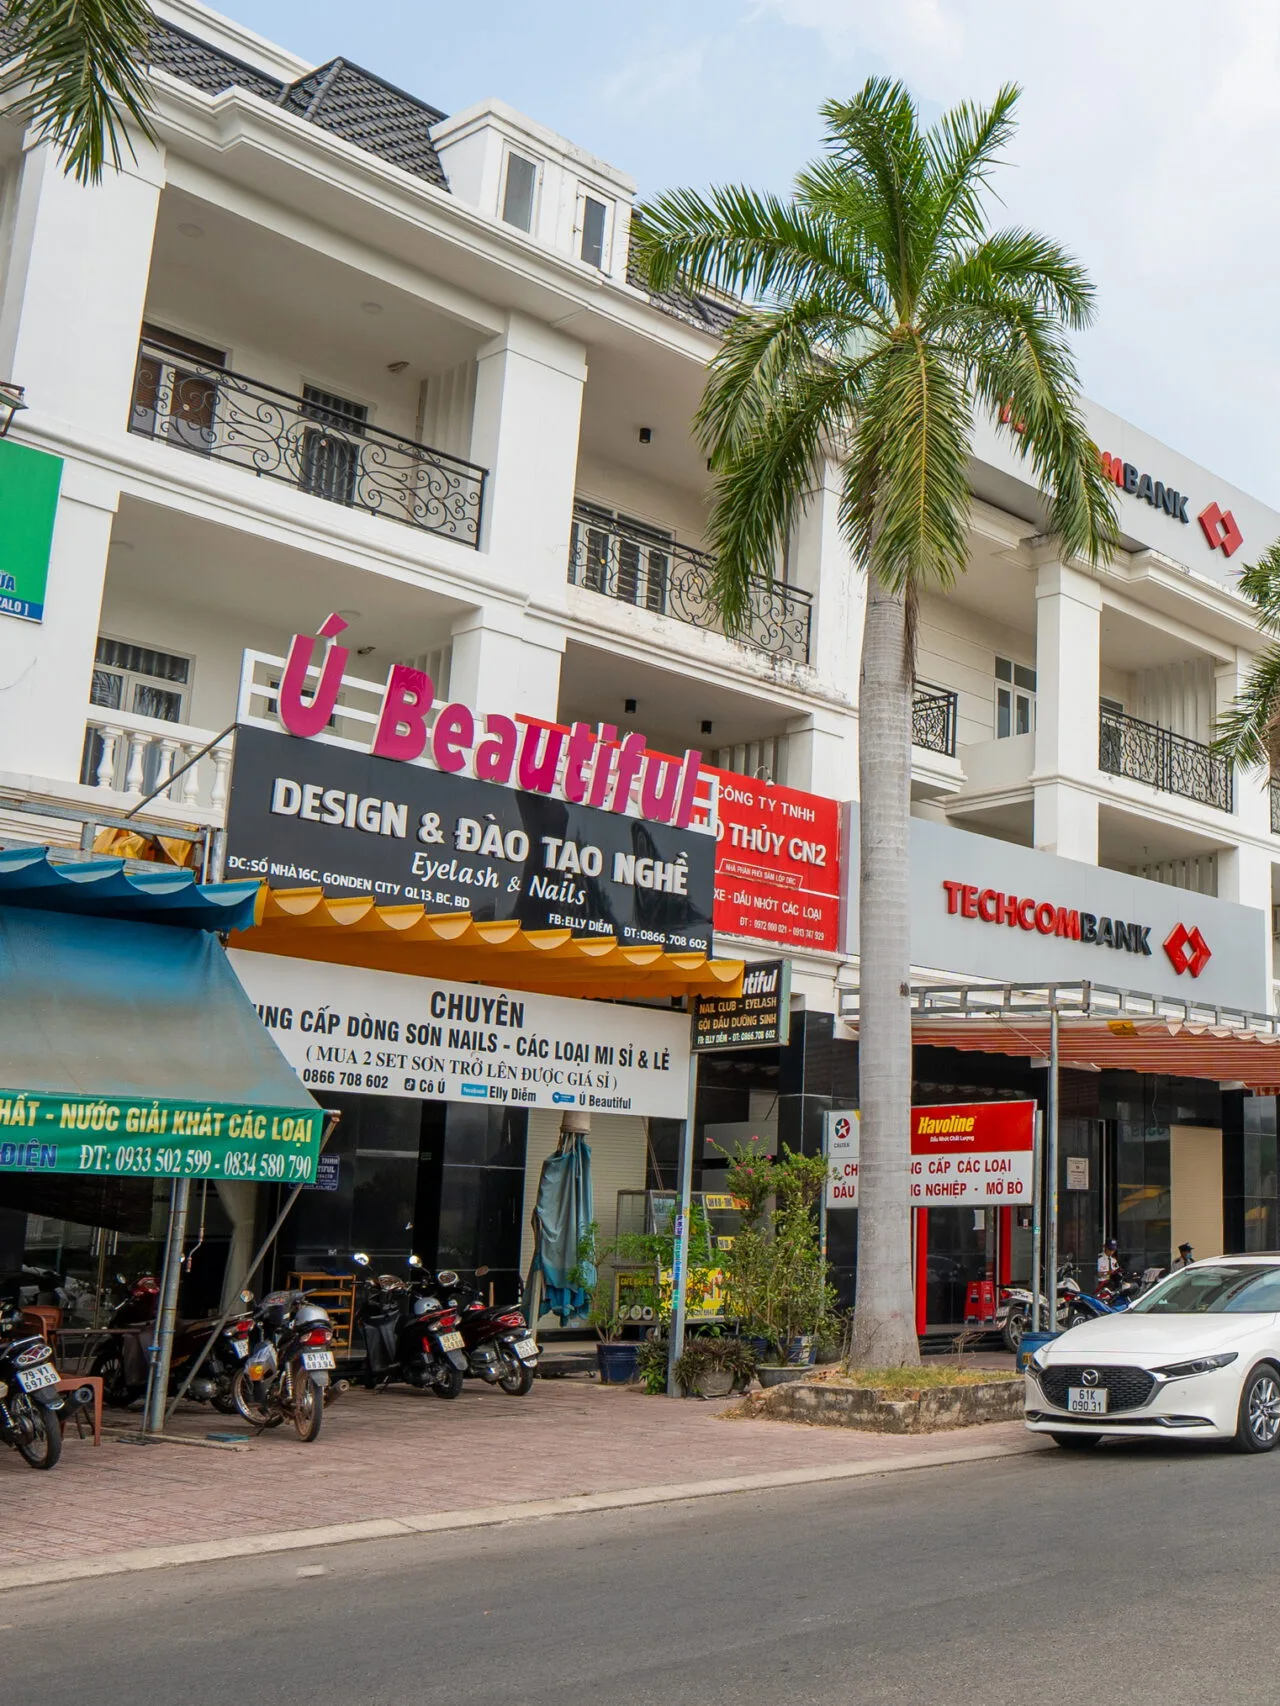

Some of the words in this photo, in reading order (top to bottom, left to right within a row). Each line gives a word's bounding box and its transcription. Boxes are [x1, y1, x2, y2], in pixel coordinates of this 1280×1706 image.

[277, 612, 349, 739] Ú
[372, 664, 702, 829] Beautiful
[717, 785, 753, 806] CÔNG
[758, 796, 777, 812] TY
[780, 802, 815, 823] TNHH
[270, 777, 409, 839] DESIGN
[416, 812, 446, 844] &
[454, 813, 530, 862] ĐÀO
[541, 836, 603, 878] TẠO
[612, 851, 689, 896] NGHỀ
[729, 823, 785, 856] THỦY
[788, 837, 828, 867] CN2
[322, 873, 373, 892] GONDEN
[375, 881, 401, 897] CITY
[412, 852, 499, 889] Eyelash
[507, 876, 521, 892] &
[529, 875, 586, 906] Nails
[713, 888, 726, 901] XE
[733, 890, 751, 906] DẦU
[754, 894, 779, 909] NHỚT
[781, 900, 800, 915] CÁC
[803, 906, 822, 921] LOẠI
[943, 880, 1152, 956] TECHCOMBANK
[688, 938, 708, 950] 602
[430, 991, 525, 1029] CHUYÊN
[698, 1020, 710, 1031] GỘI
[713, 1016, 729, 1029] ĐẦU
[759, 1013, 777, 1024] SINH
[699, 1003, 716, 1014] NAIL
[718, 1001, 737, 1013] CLUB
[745, 996, 777, 1010] EYELASH
[300, 1005, 341, 1035] CẤP
[347, 1013, 400, 1042] DÒNG
[406, 1022, 442, 1047] SƠN
[448, 1028, 498, 1053] NAILS
[516, 1033, 549, 1059] CÁC
[555, 1040, 590, 1067] LOẠI
[595, 1045, 614, 1066] MI
[618, 1043, 633, 1067] SỈ
[638, 1050, 648, 1069] &
[654, 1048, 670, 1071] LẺ
[317, 1045, 358, 1065] MUA
[363, 1050, 372, 1066] 2
[375, 1052, 408, 1069] SET
[411, 1054, 446, 1074] SƠN
[450, 1056, 483, 1077] TRỞ
[487, 1060, 518, 1080] LÊN
[521, 1065, 564, 1087] ĐƯỢC
[567, 1071, 592, 1088] GIÁ
[596, 1074, 609, 1090] SỈ
[302, 1068, 335, 1085] 0866
[339, 1071, 362, 1088] 708
[366, 1073, 389, 1090] 602
[419, 1078, 434, 1093] Cô
[438, 1078, 446, 1094] Ú
[489, 1085, 508, 1101] Elly
[511, 1087, 537, 1102] Diễm
[579, 1091, 586, 1106] Ú
[589, 1094, 632, 1110] Beautiful
[59, 1099, 120, 1131] NƯỚC
[125, 1101, 167, 1135] GIẢI
[171, 1105, 225, 1137] KHÁT
[228, 1107, 266, 1139] CÁC
[272, 1114, 313, 1149] LOẠI
[918, 1115, 975, 1134] Havoline
[80, 1144, 111, 1171] ĐT:
[115, 1145, 151, 1172] 0933
[154, 1146, 182, 1173] 502
[184, 1147, 212, 1174] 599
[223, 1149, 257, 1177] 0834
[259, 1152, 285, 1178] 580
[288, 1154, 312, 1180] 790
[928, 1156, 951, 1175] CẤP
[957, 1157, 981, 1173] CÁC
[984, 1159, 1012, 1175] LOẠI
[834, 1181, 855, 1199] DẦU
[925, 1179, 967, 1199] NGHIỆP
[986, 1178, 1004, 1196] MỠ
[1007, 1177, 1023, 1195] BÒ
[1072, 1400, 1101, 1411] 090.31
[1079, 1389, 1096, 1400] 61K
